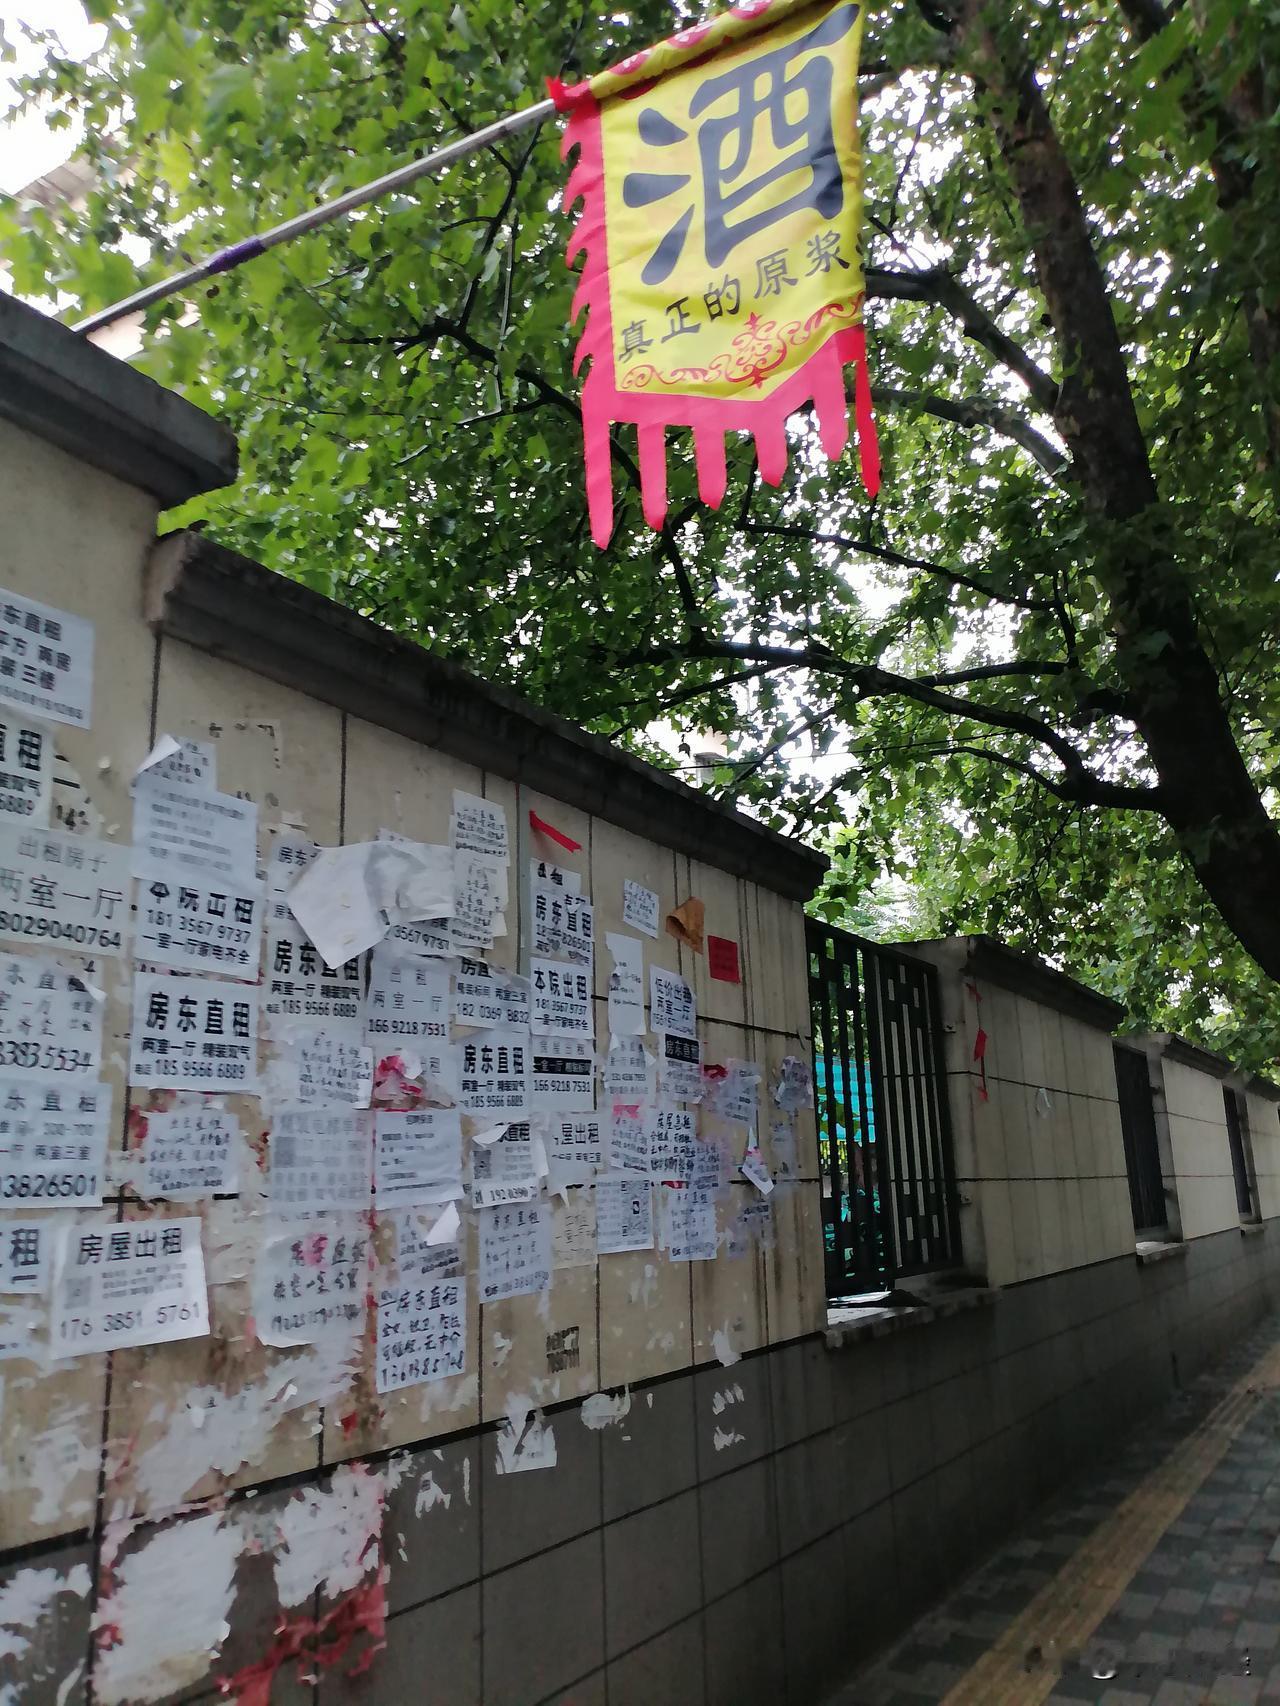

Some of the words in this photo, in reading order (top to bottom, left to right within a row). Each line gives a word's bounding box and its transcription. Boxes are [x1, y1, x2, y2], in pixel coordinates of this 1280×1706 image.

[622, 3, 860, 286] 酒
[617, 230, 850, 363] 真正的原浆
[217, 924, 250, 945] 9737
[534, 968, 587, 1001] 本院出租
[146, 991, 250, 1038] 房东直租
[368, 1019, 389, 1034] 166
[391, 1020, 418, 1036] 9218
[421, 1022, 447, 1037] 7531
[142, 1036, 196, 1056] 两室一厅
[464, 1044, 524, 1075] 房东直租
[0, 1174, 97, 1199] 3826501
[77, 1227, 182, 1266] 房屋出租
